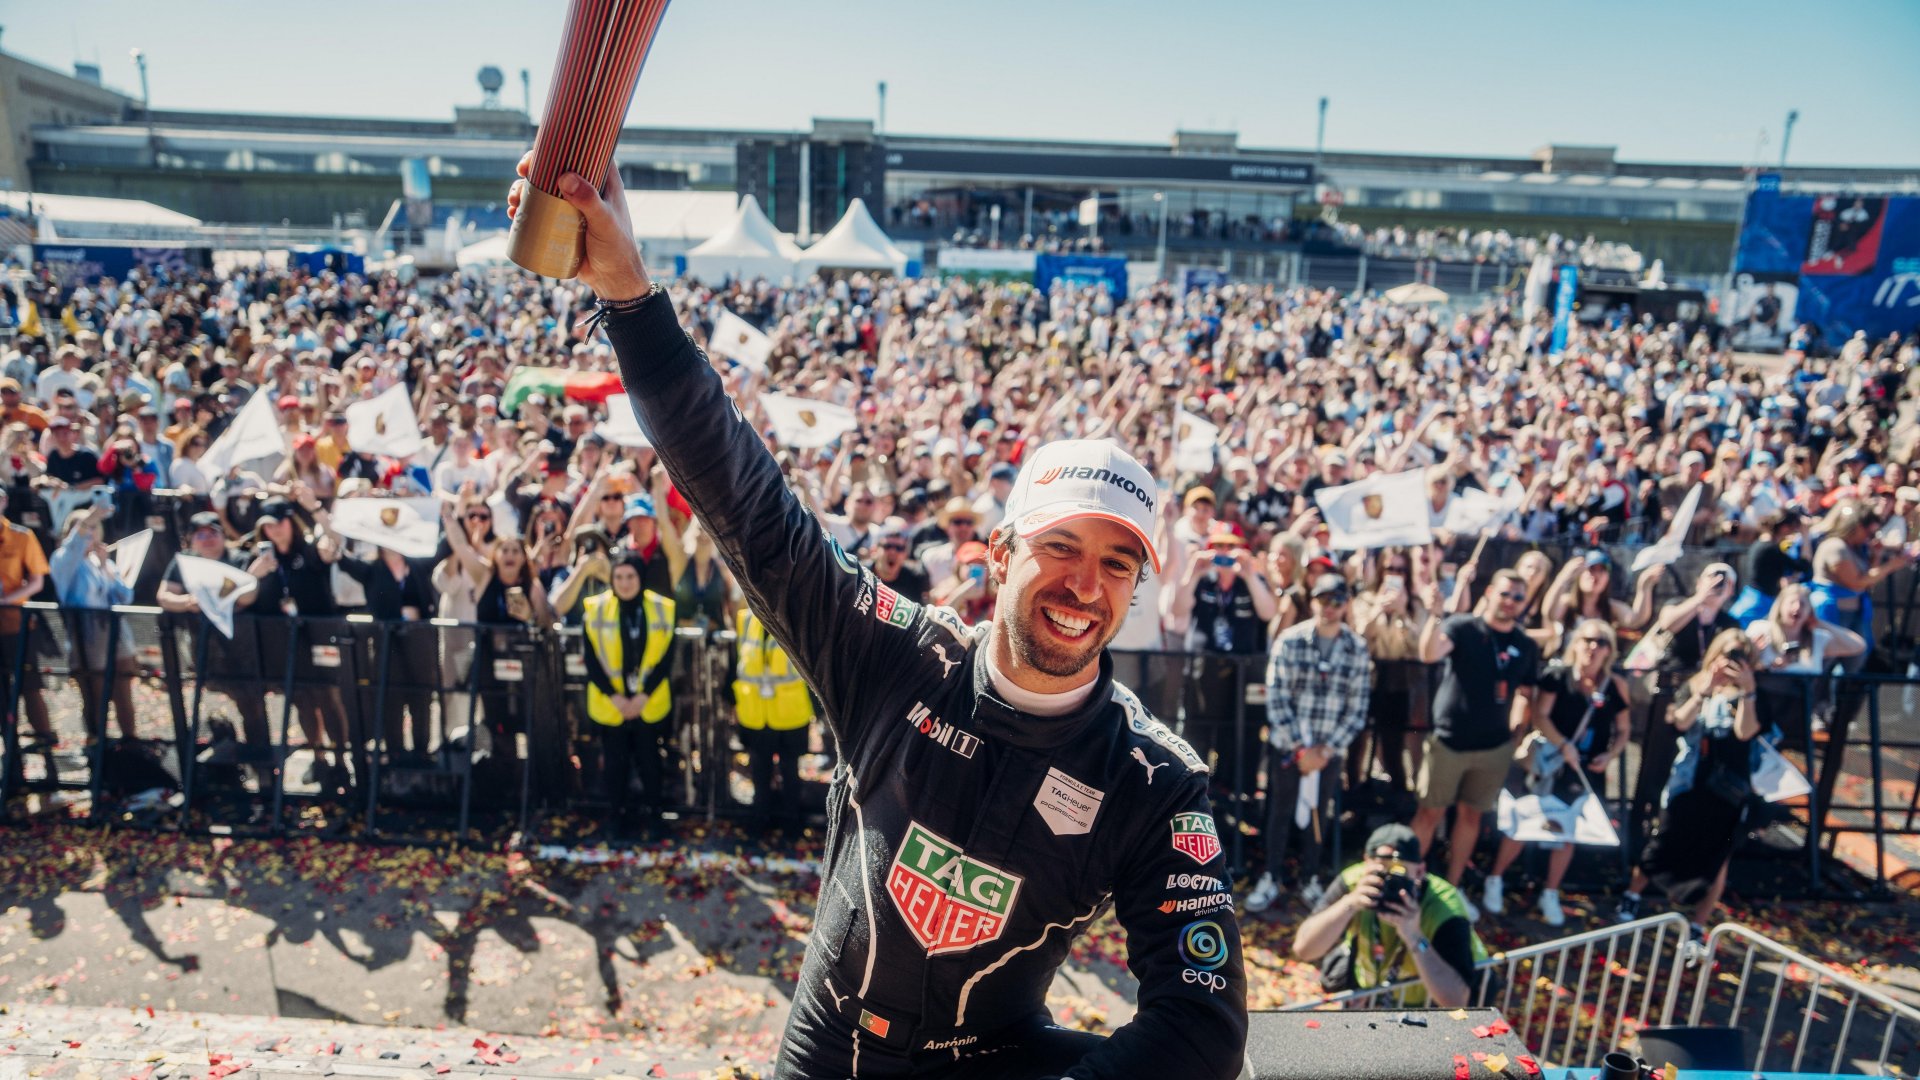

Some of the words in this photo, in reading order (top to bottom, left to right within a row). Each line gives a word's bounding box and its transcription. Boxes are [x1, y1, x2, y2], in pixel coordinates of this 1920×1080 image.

[906, 700, 954, 747] Mobil
[1060, 774, 1080, 789] FORMULA
[1083, 787, 1096, 796] TEAM
[1040, 800, 1088, 828] PORSCHE
[1176, 816, 1217, 833] TAG
[1176, 835, 1219, 859] HEUER
[915, 834, 1005, 908] TAG
[1166, 873, 1225, 892] LOCTITE
[893, 870, 996, 945] HEUER
[1195, 906, 1219, 917] driving
[923, 1035, 978, 1050] António
